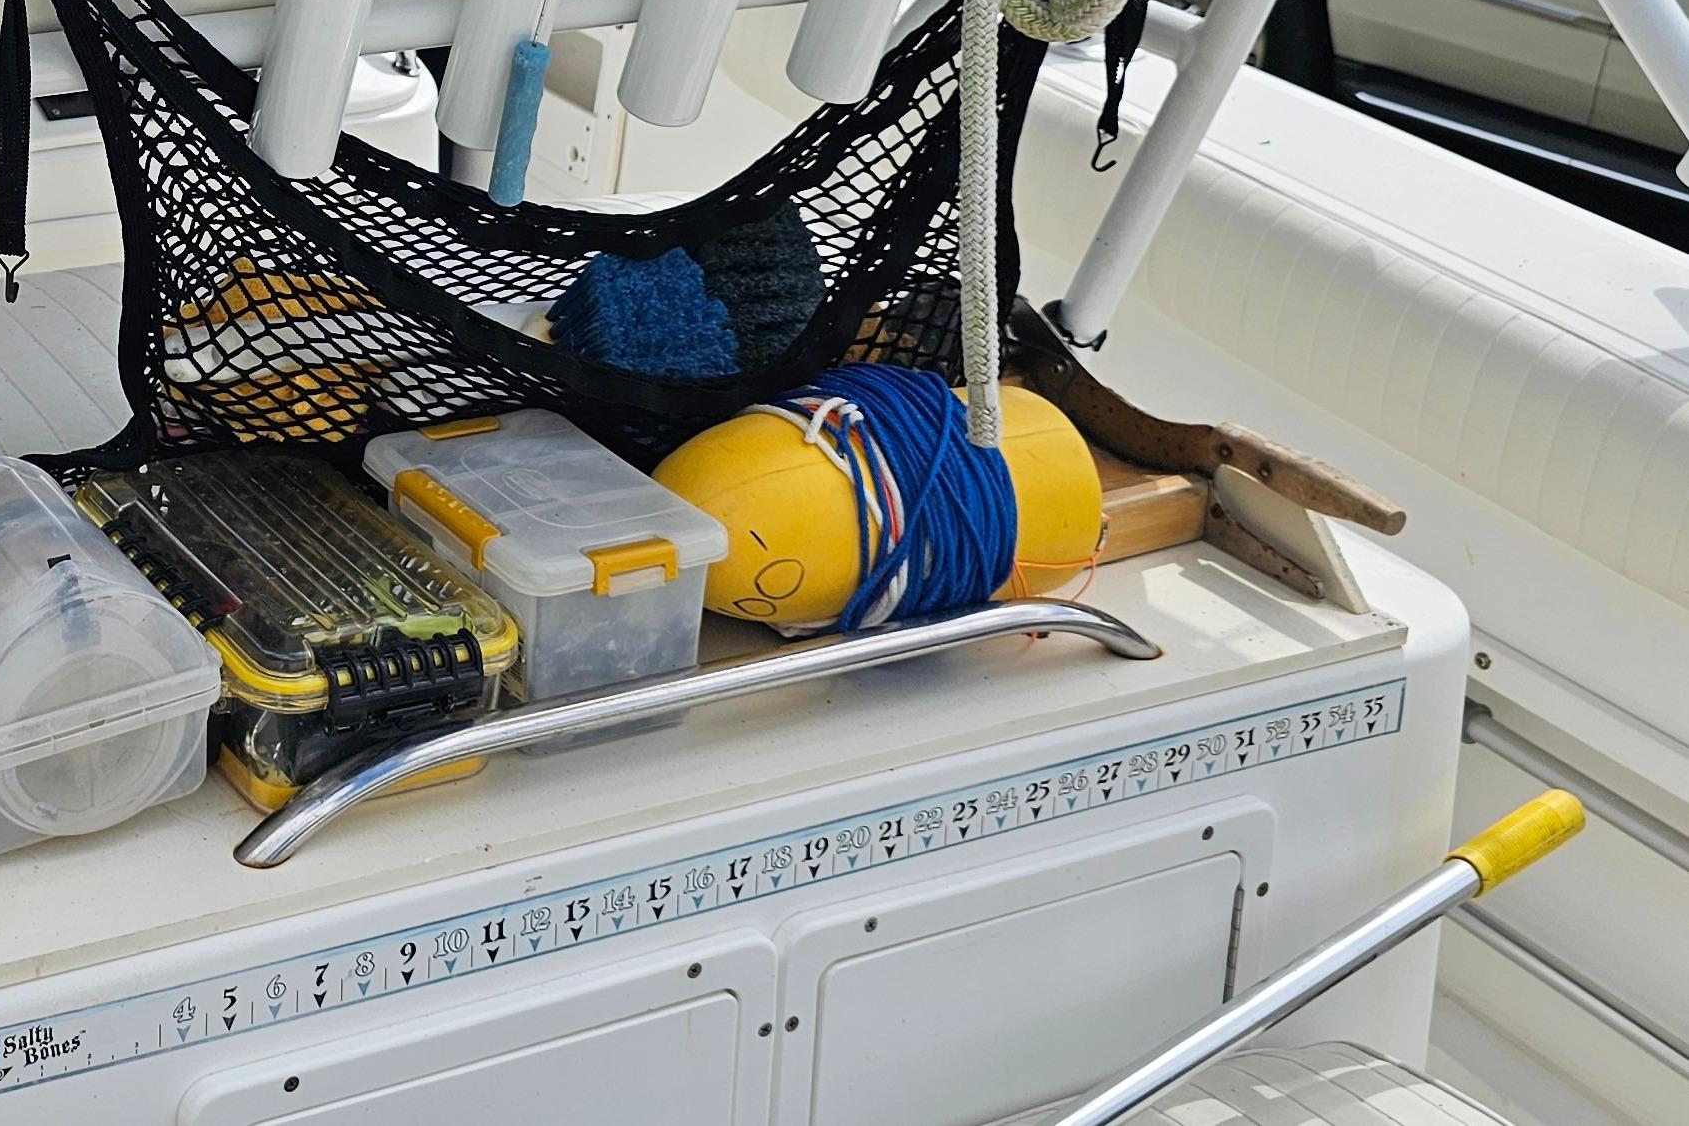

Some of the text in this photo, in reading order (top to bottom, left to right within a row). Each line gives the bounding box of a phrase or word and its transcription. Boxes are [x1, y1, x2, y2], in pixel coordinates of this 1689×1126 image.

[173, 997, 195, 1023] 4
[223, 986, 238, 1011] 5
[266, 974, 287, 999] 6
[314, 963, 329, 986] 7
[354, 952, 375, 977] 8
[399, 942, 417, 965] 9
[432, 928, 470, 959] 10
[481, 918, 507, 945] 11
[520, 907, 552, 936] 12
[564, 897, 591, 923] 13
[601, 885, 635, 915] 14
[646, 876, 672, 903] 15
[683, 865, 715, 895] 16
[726, 856, 752, 882] 17
[761, 845, 792, 874] 18
[801, 837, 829, 863] 19
[835, 825, 871, 855] 20
[879, 817, 904, 842] 21
[913, 806, 944, 834] 22
[985, 787, 1019, 815] 24
[1025, 778, 1052, 803] 25
[1057, 769, 1089, 797] 26
[1096, 760, 1123, 785] 27
[1128, 751, 1159, 778] 28
[1164, 743, 1191, 768] 29
[2, 1025, 54, 1059] Salty
[24, 1035, 81, 1067] Bones
